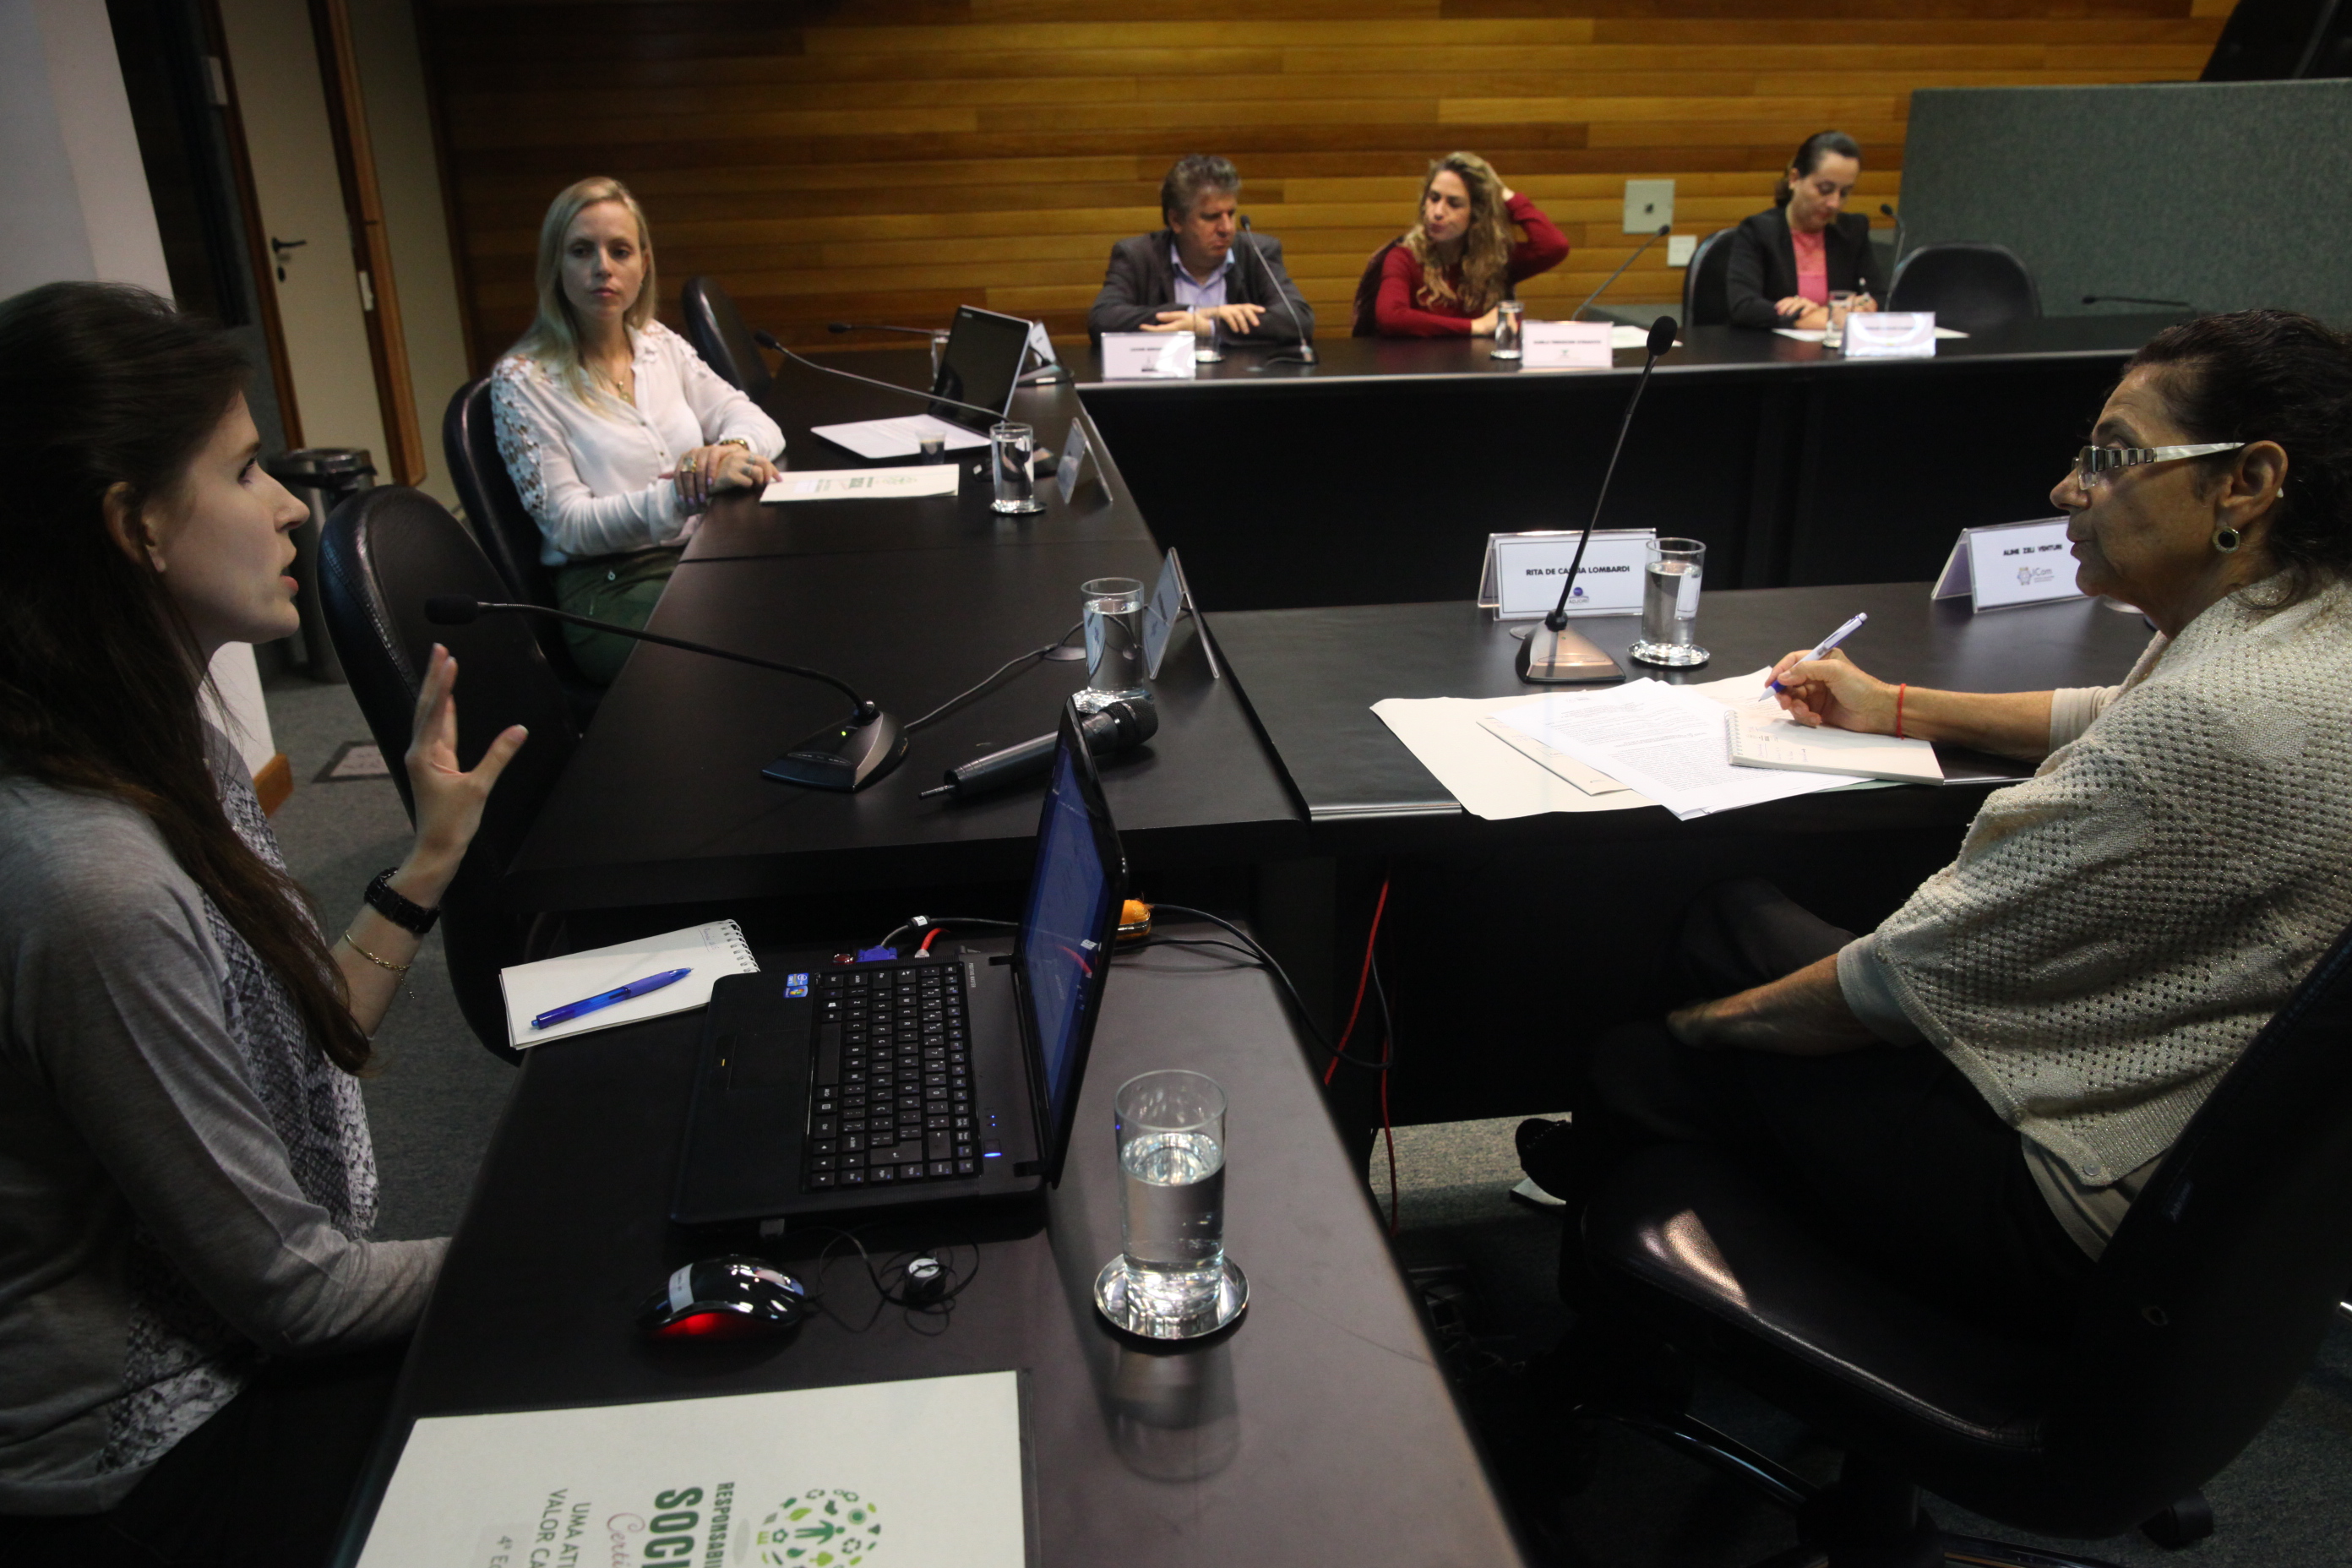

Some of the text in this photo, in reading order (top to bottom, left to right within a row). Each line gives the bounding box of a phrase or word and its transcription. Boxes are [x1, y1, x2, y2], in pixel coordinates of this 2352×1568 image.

[1588, 565, 1631, 574] LOMBARDI
[536, 1488, 569, 1544] VALOR
[564, 1501, 591, 1540] UMA
